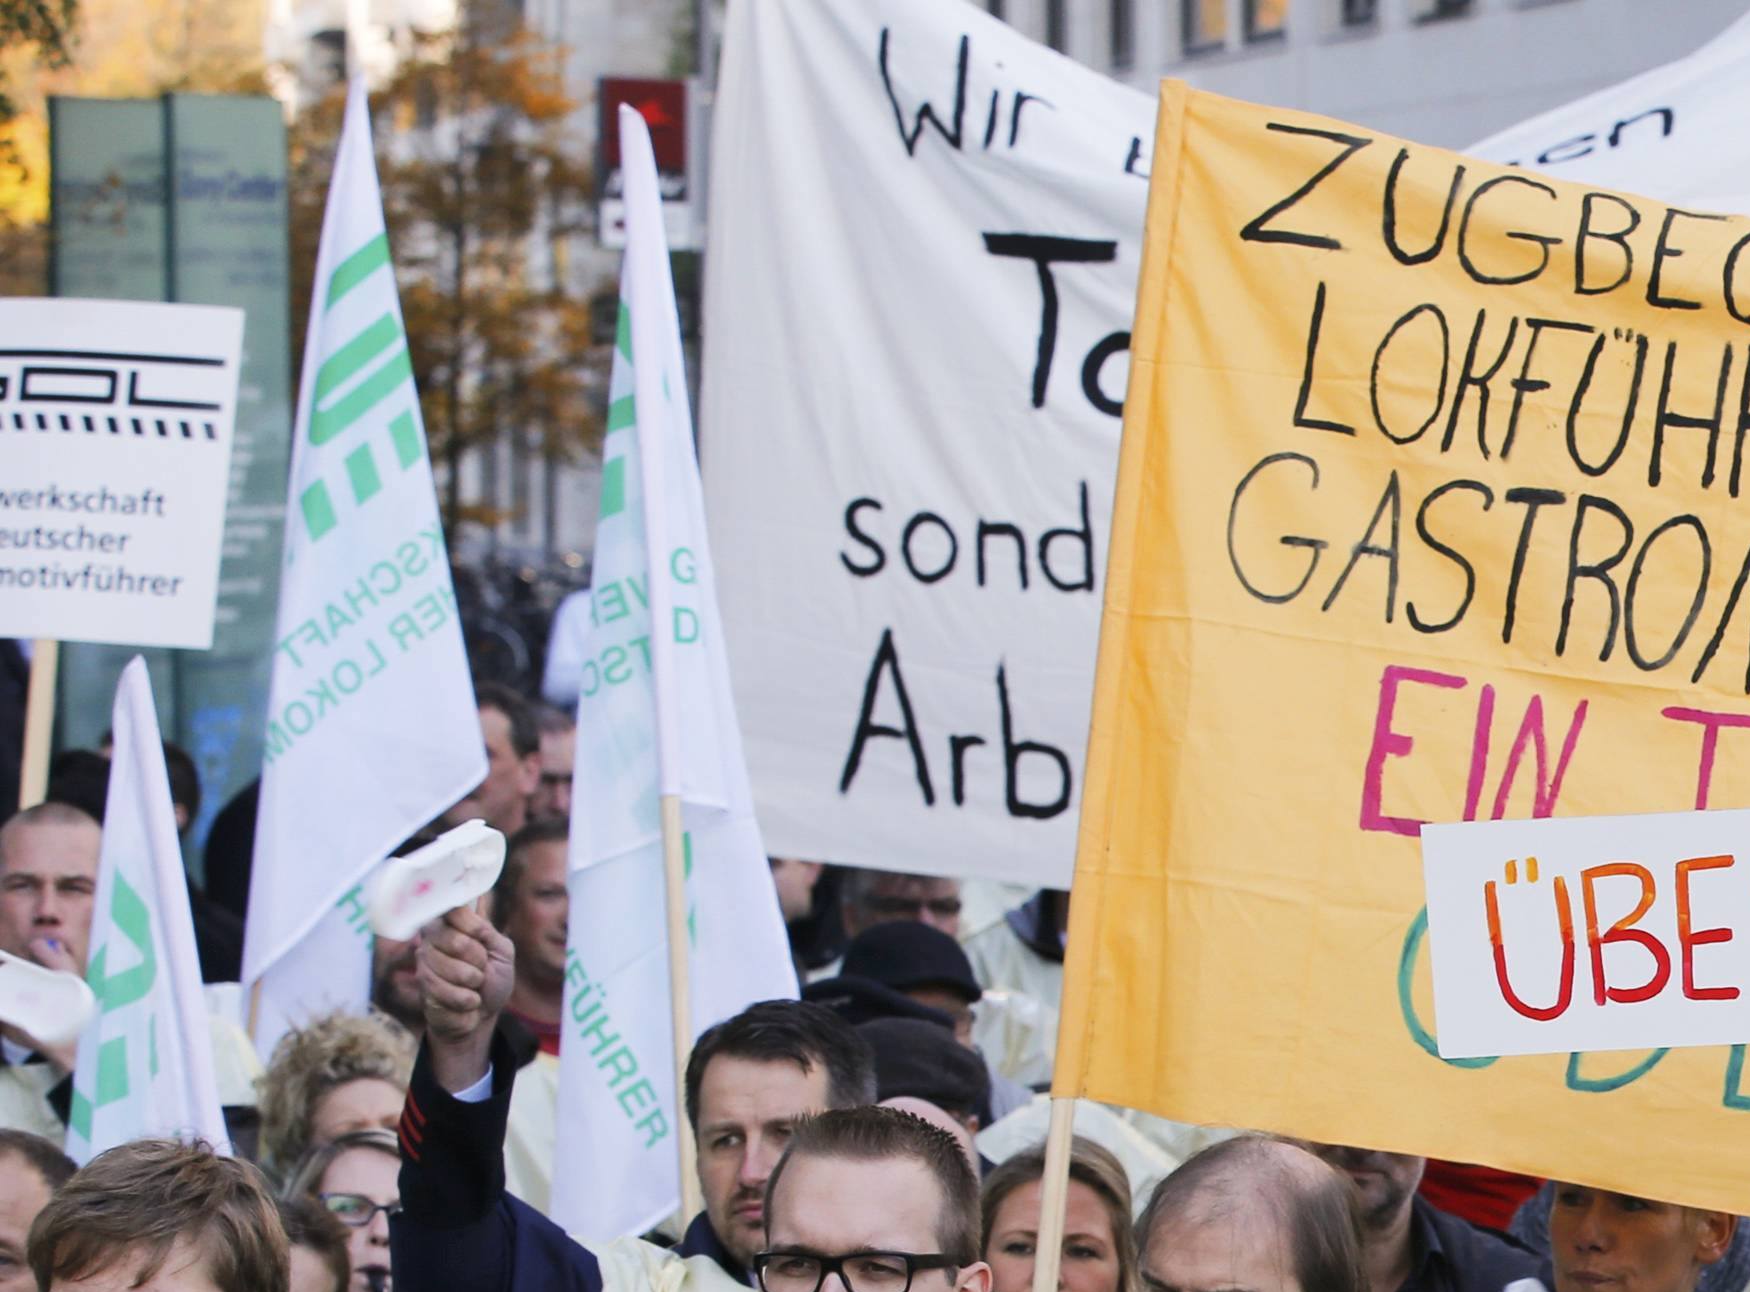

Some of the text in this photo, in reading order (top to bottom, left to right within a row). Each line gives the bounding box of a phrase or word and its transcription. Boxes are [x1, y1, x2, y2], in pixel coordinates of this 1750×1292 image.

[879, 27, 1056, 157] Wir
[839, 481, 1095, 592] sond
[838, 626, 1074, 821] Arb
[1360, 664, 1589, 838] EIN
[566, 948, 670, 1149] FÜHRER
